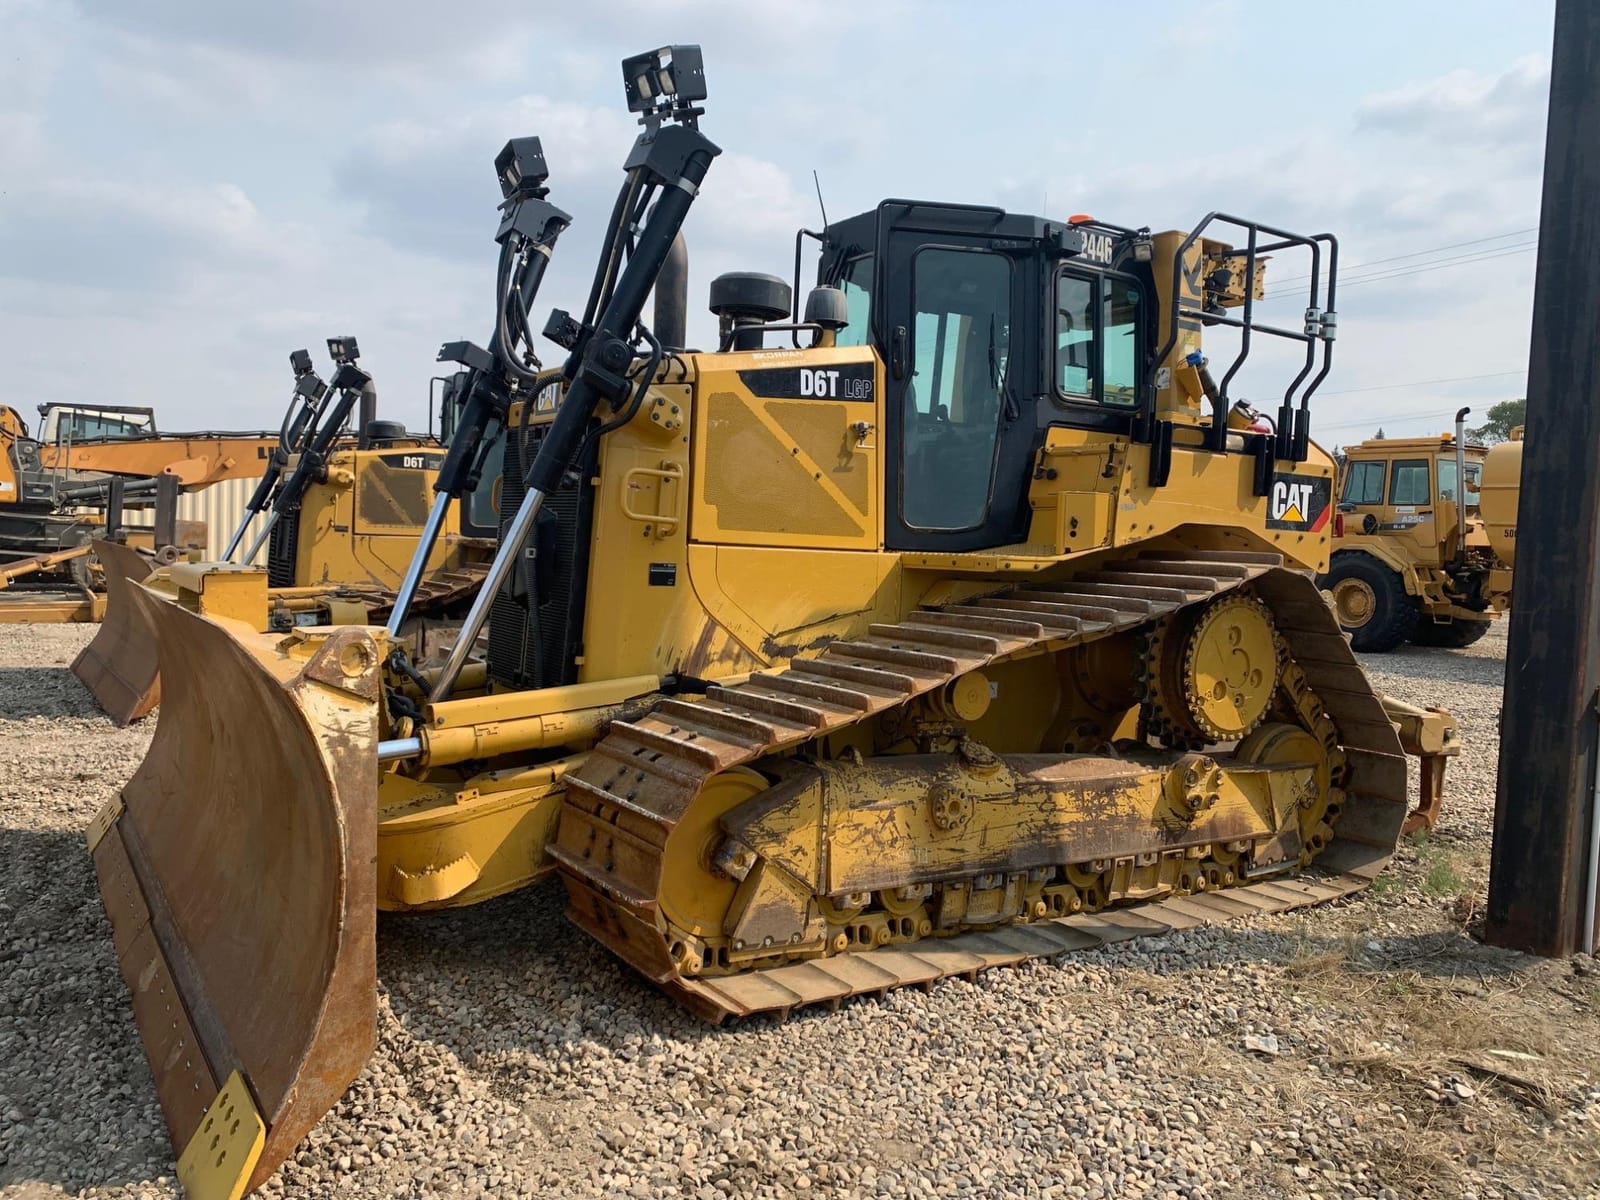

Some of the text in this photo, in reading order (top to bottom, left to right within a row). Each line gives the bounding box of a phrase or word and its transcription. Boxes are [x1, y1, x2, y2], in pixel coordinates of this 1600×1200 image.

[1072, 230, 1112, 265] 2446
[537, 382, 560, 411] CAT
[800, 368, 873, 399] D6T LGP
[403, 456, 425, 469] D6T
[1272, 481, 1313, 522] CAT
[1402, 515, 1425, 523] A25C
